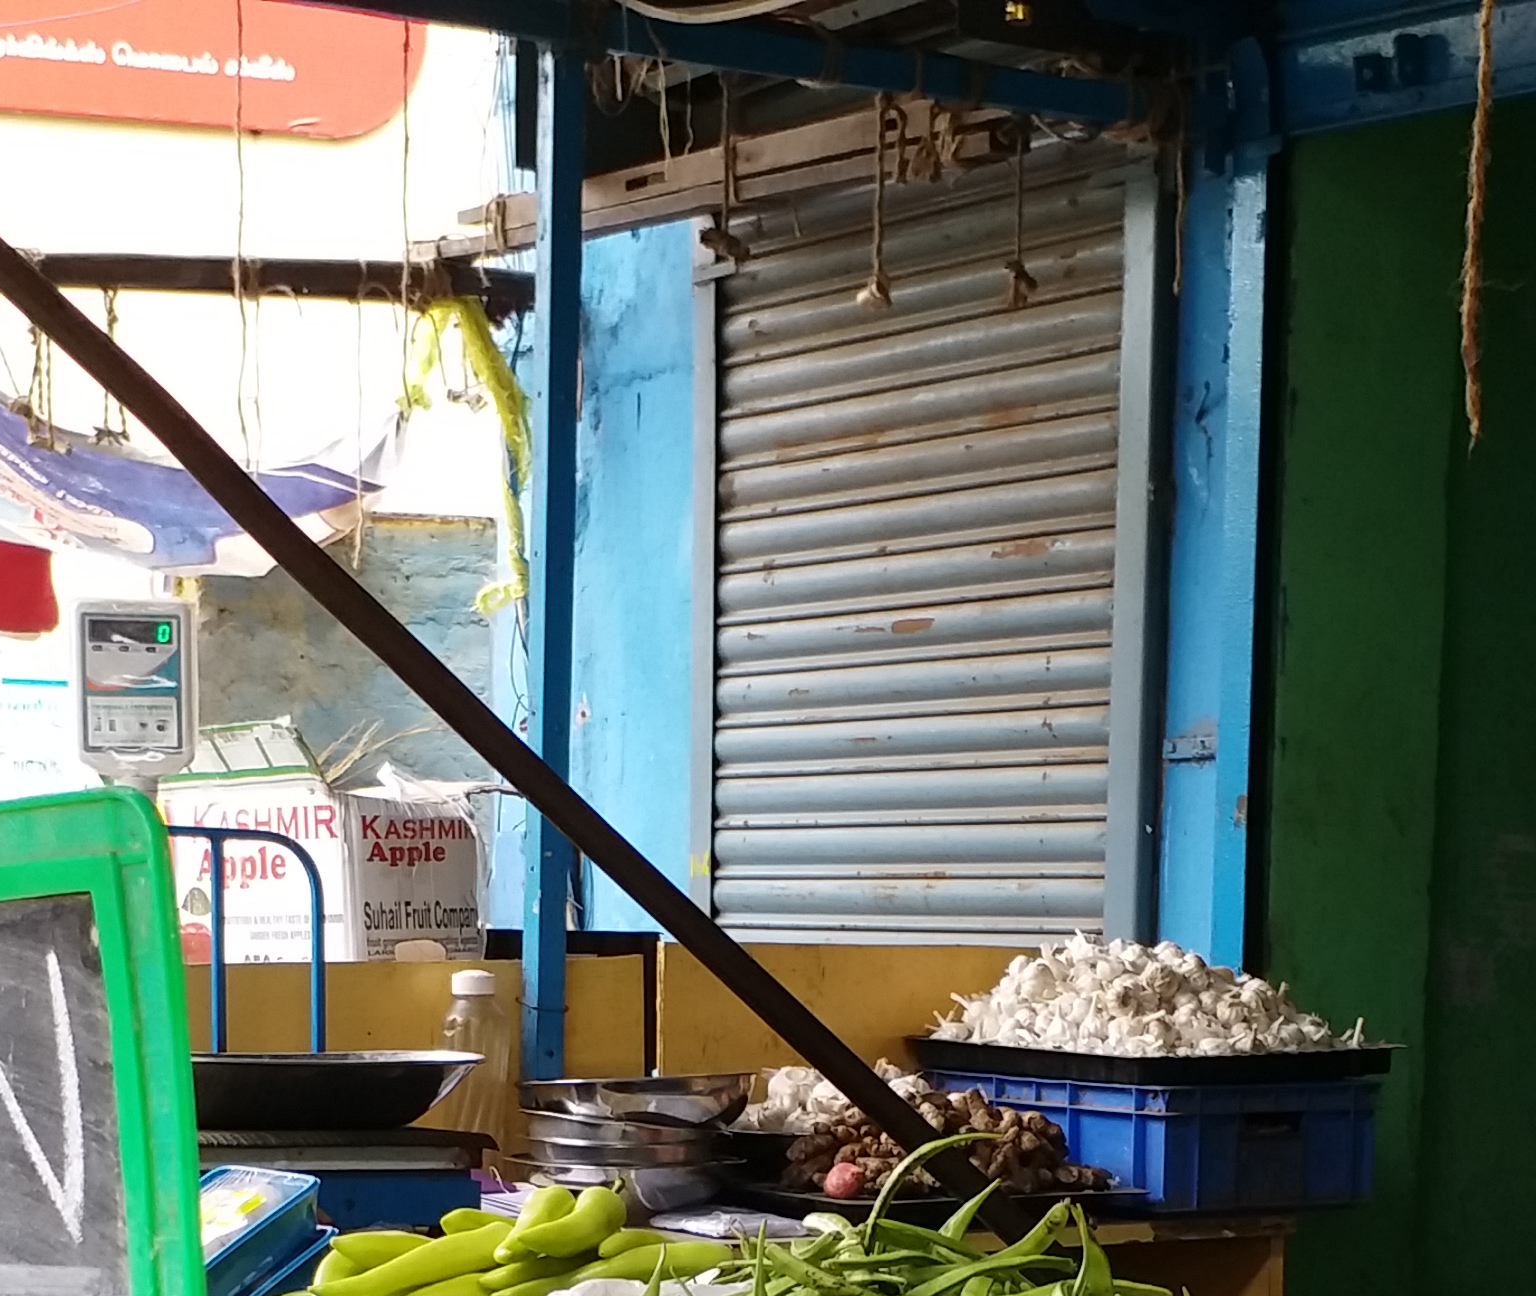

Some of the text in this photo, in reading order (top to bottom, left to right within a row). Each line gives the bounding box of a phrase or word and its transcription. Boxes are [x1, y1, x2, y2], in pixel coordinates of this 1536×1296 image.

[156, 623, 171, 644] 0
[193, 804, 339, 841] KASHMIR
[196, 846, 287, 889] Apple
[366, 841, 446, 867] Apple
[364, 900, 480, 936] Suhail Fruit Compan
